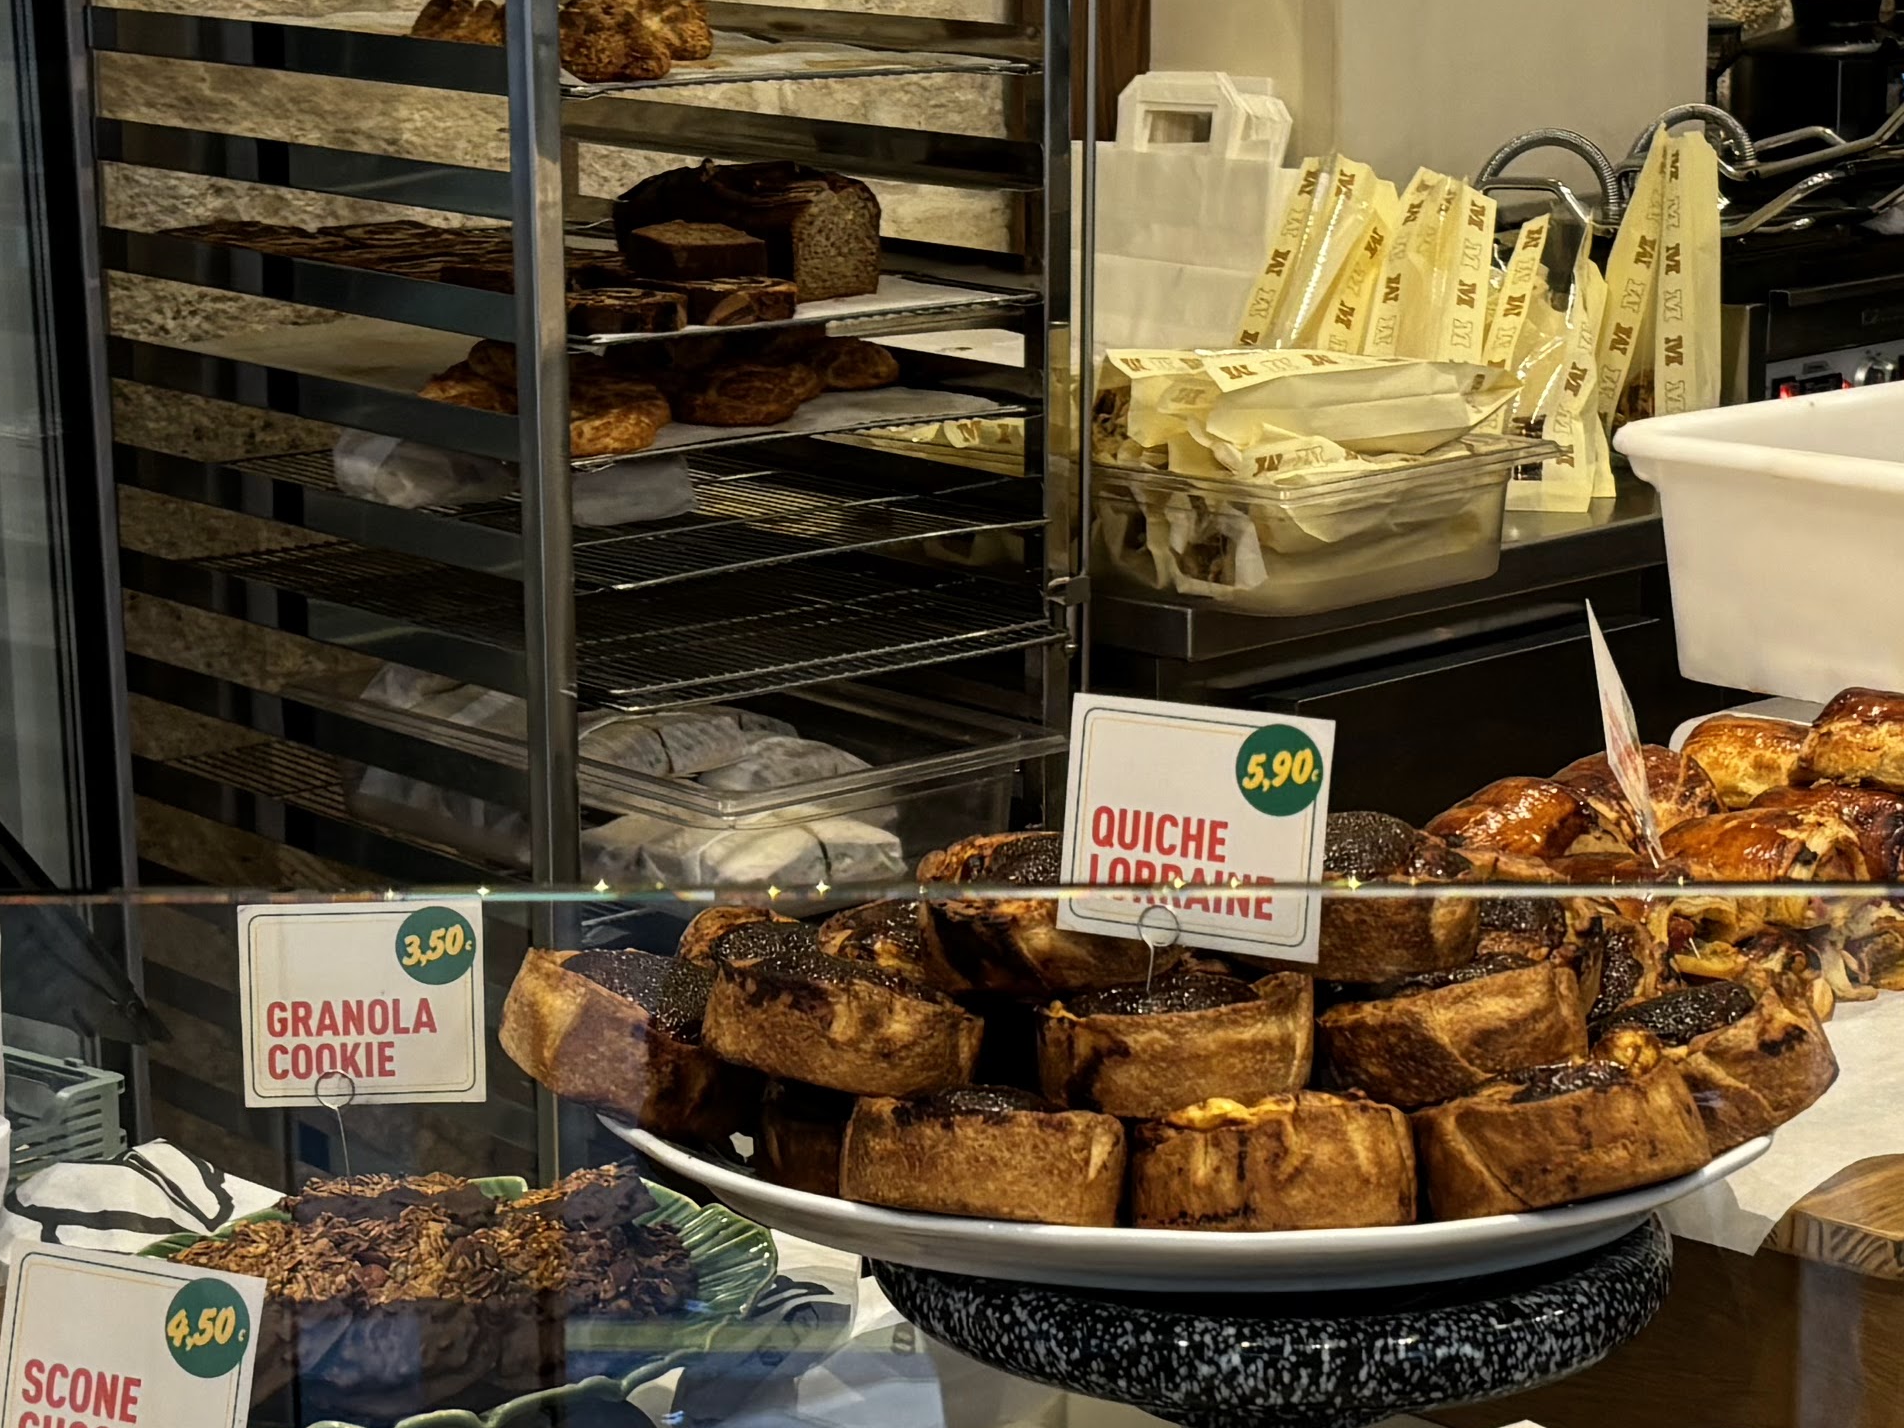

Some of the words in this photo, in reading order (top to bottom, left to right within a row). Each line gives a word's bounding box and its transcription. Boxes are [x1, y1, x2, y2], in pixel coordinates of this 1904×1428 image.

[1091, 805, 1229, 863] QUICHE
[1089, 854, 1275, 921] LORRAINE
[266, 997, 437, 1038] GRANOLA
[268, 1041, 396, 1080] COOKIE
[22, 1358, 142, 1424] SCONE
